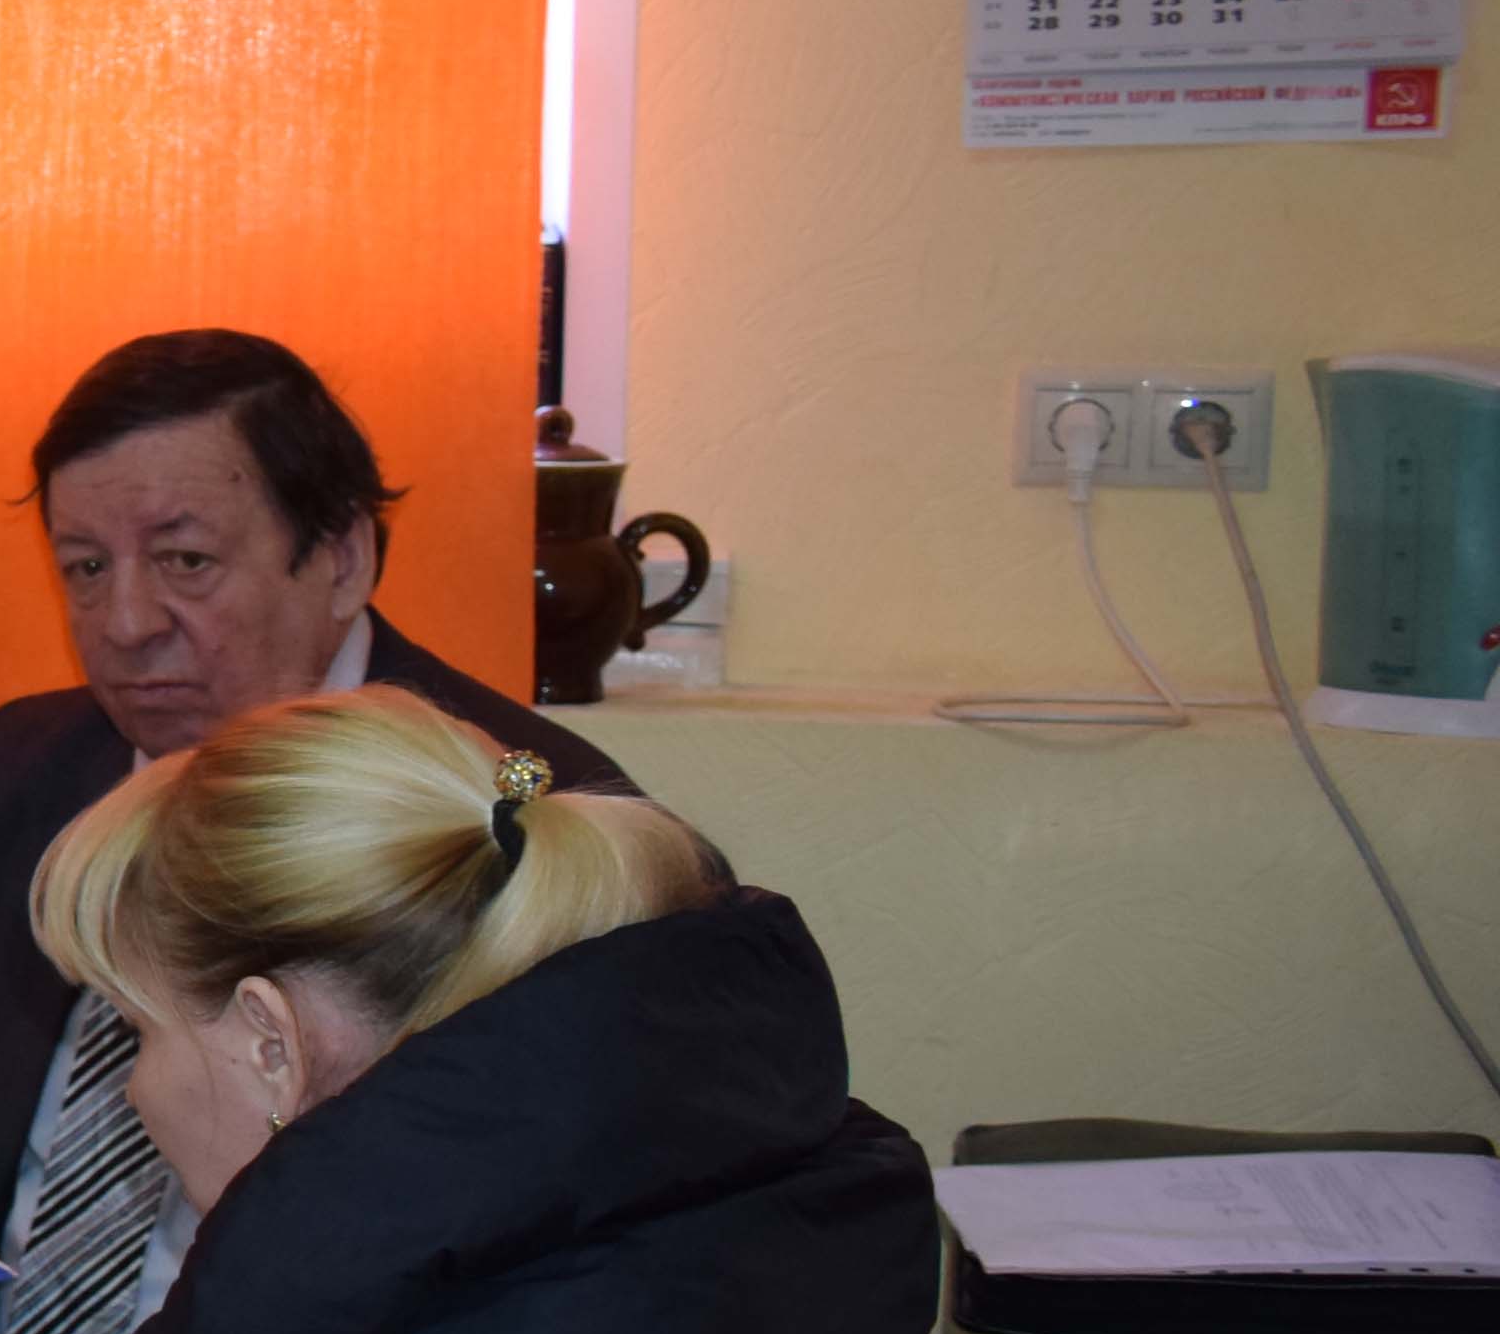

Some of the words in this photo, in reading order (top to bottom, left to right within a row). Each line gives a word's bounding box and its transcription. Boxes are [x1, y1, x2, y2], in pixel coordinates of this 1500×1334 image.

[1088, 13, 1121, 29] 29
[1151, 10, 1184, 27] 30
[1213, 8, 1244, 24] 31
